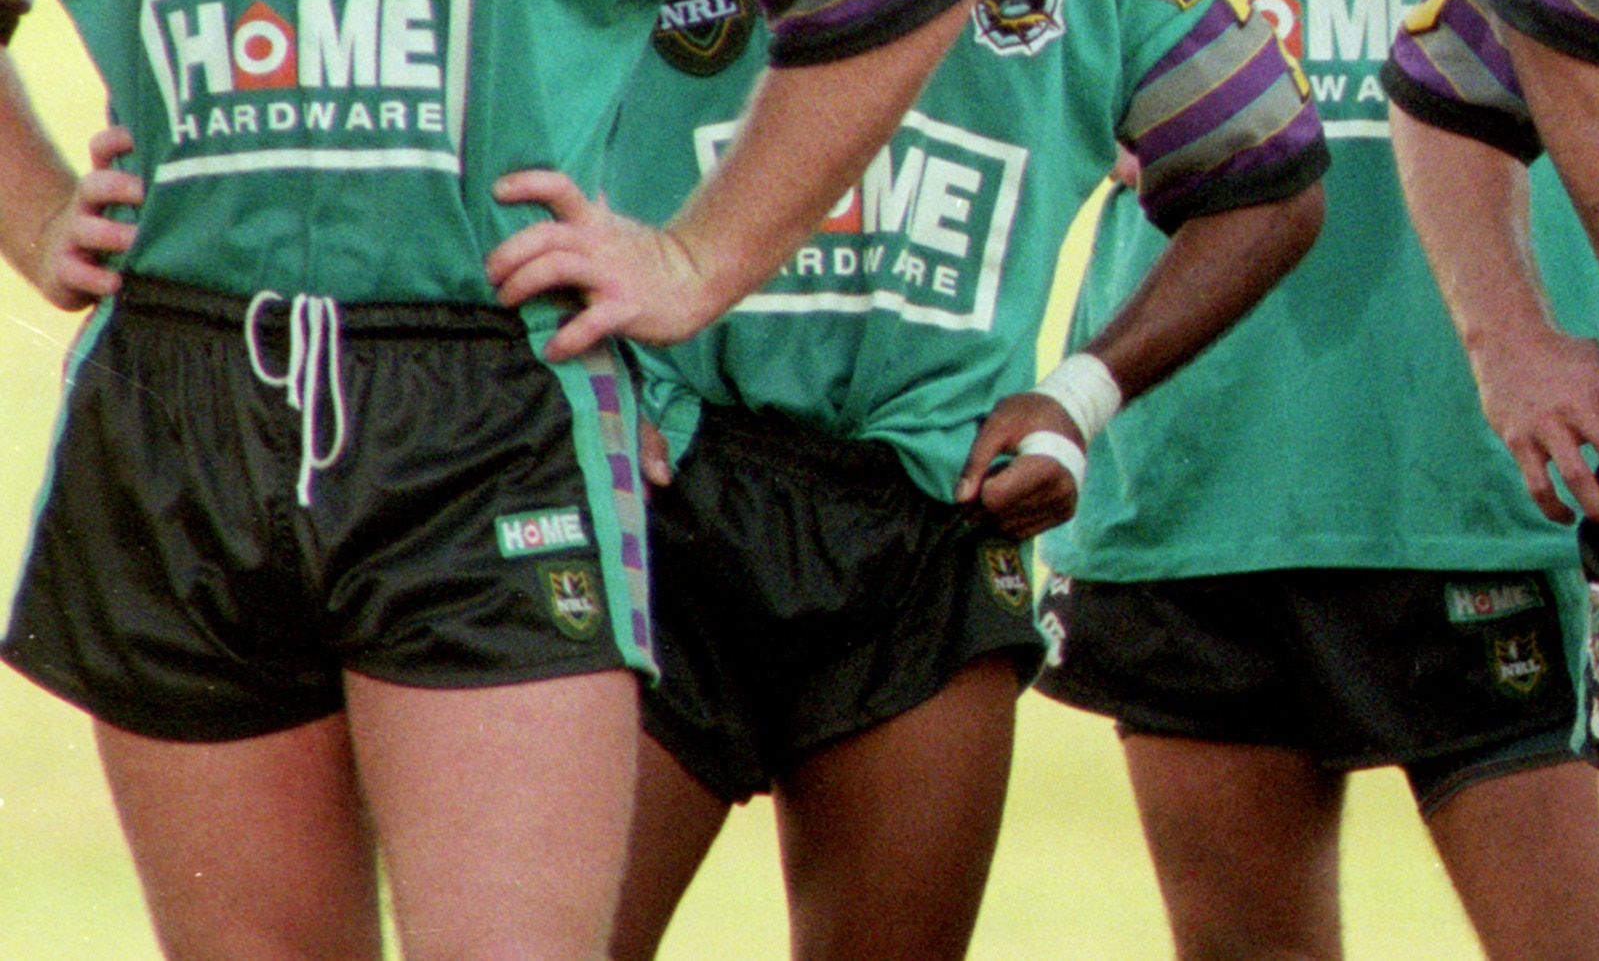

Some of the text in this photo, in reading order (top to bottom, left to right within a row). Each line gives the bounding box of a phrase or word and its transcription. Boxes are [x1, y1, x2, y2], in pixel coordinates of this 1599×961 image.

[173, 100, 444, 145] HARDWARE
[827, 144, 983, 258] ME
[779, 245, 961, 297] RDWARE
[502, 513, 586, 551] HOME
[1452, 586, 1533, 617] HOME
